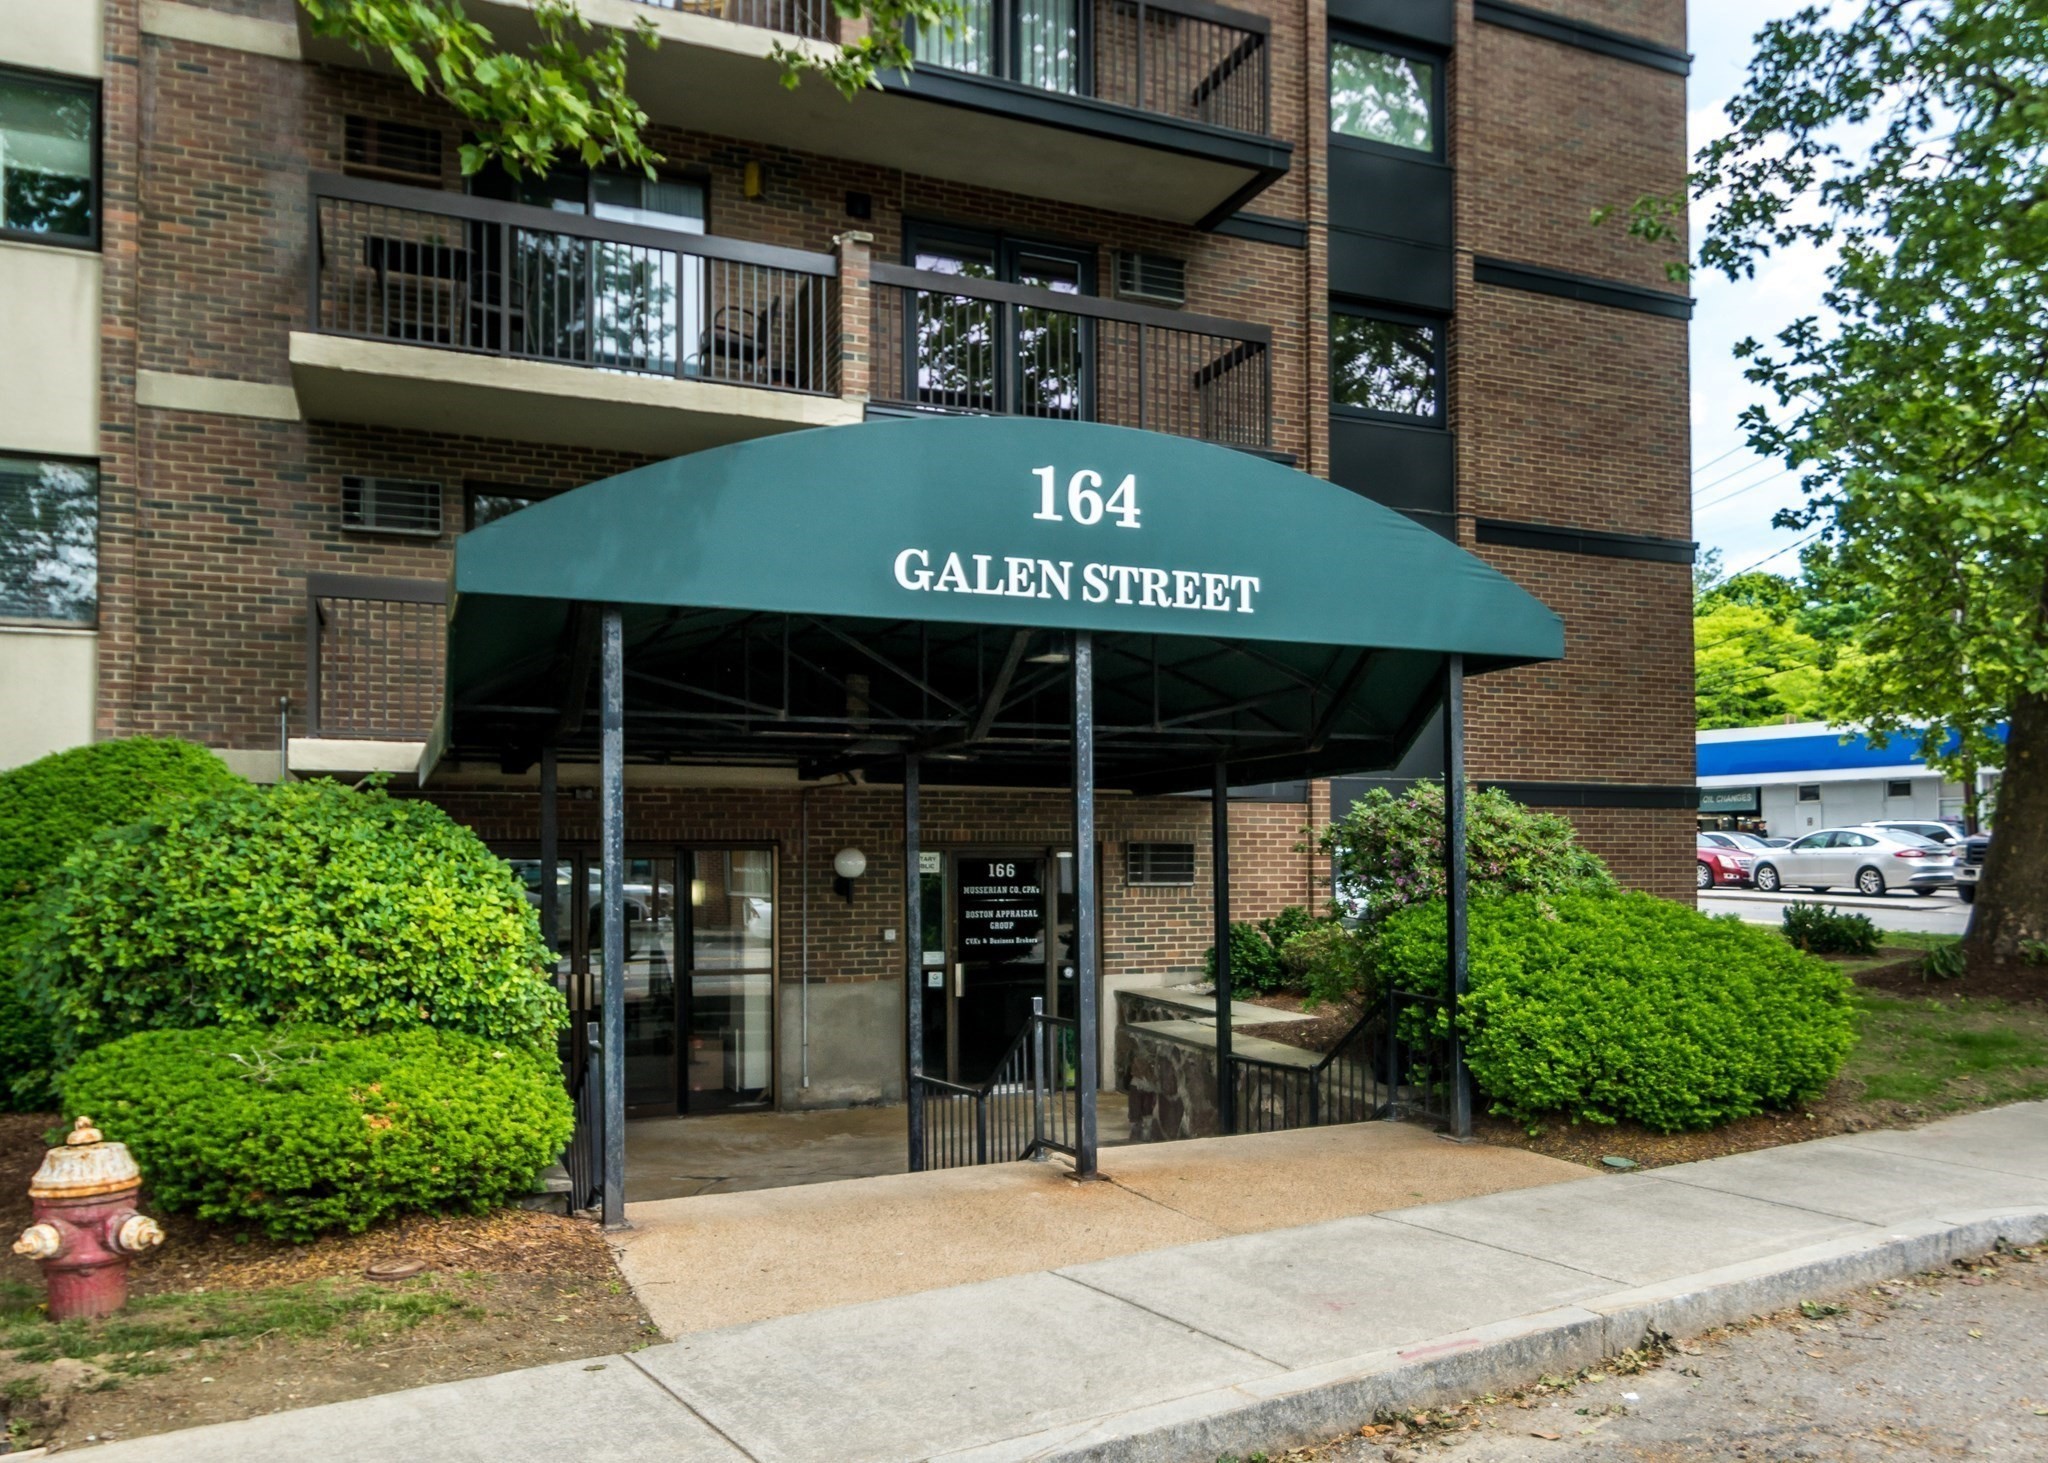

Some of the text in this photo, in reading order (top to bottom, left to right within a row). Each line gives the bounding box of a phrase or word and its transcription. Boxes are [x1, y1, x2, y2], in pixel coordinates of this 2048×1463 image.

[1032, 465, 1141, 529] 164
[893, 548, 1260, 613] GALEN STREET
[1703, 793, 1752, 804] OIL CHANGES
[988, 863, 1016, 877] 166
[963, 886, 1008, 894] MUSSERIAN
[965, 909, 1039, 919] BOSTON APPRAISAL
[989, 921, 1014, 930] GROUP
[1015, 936, 1038, 944] Brokers
